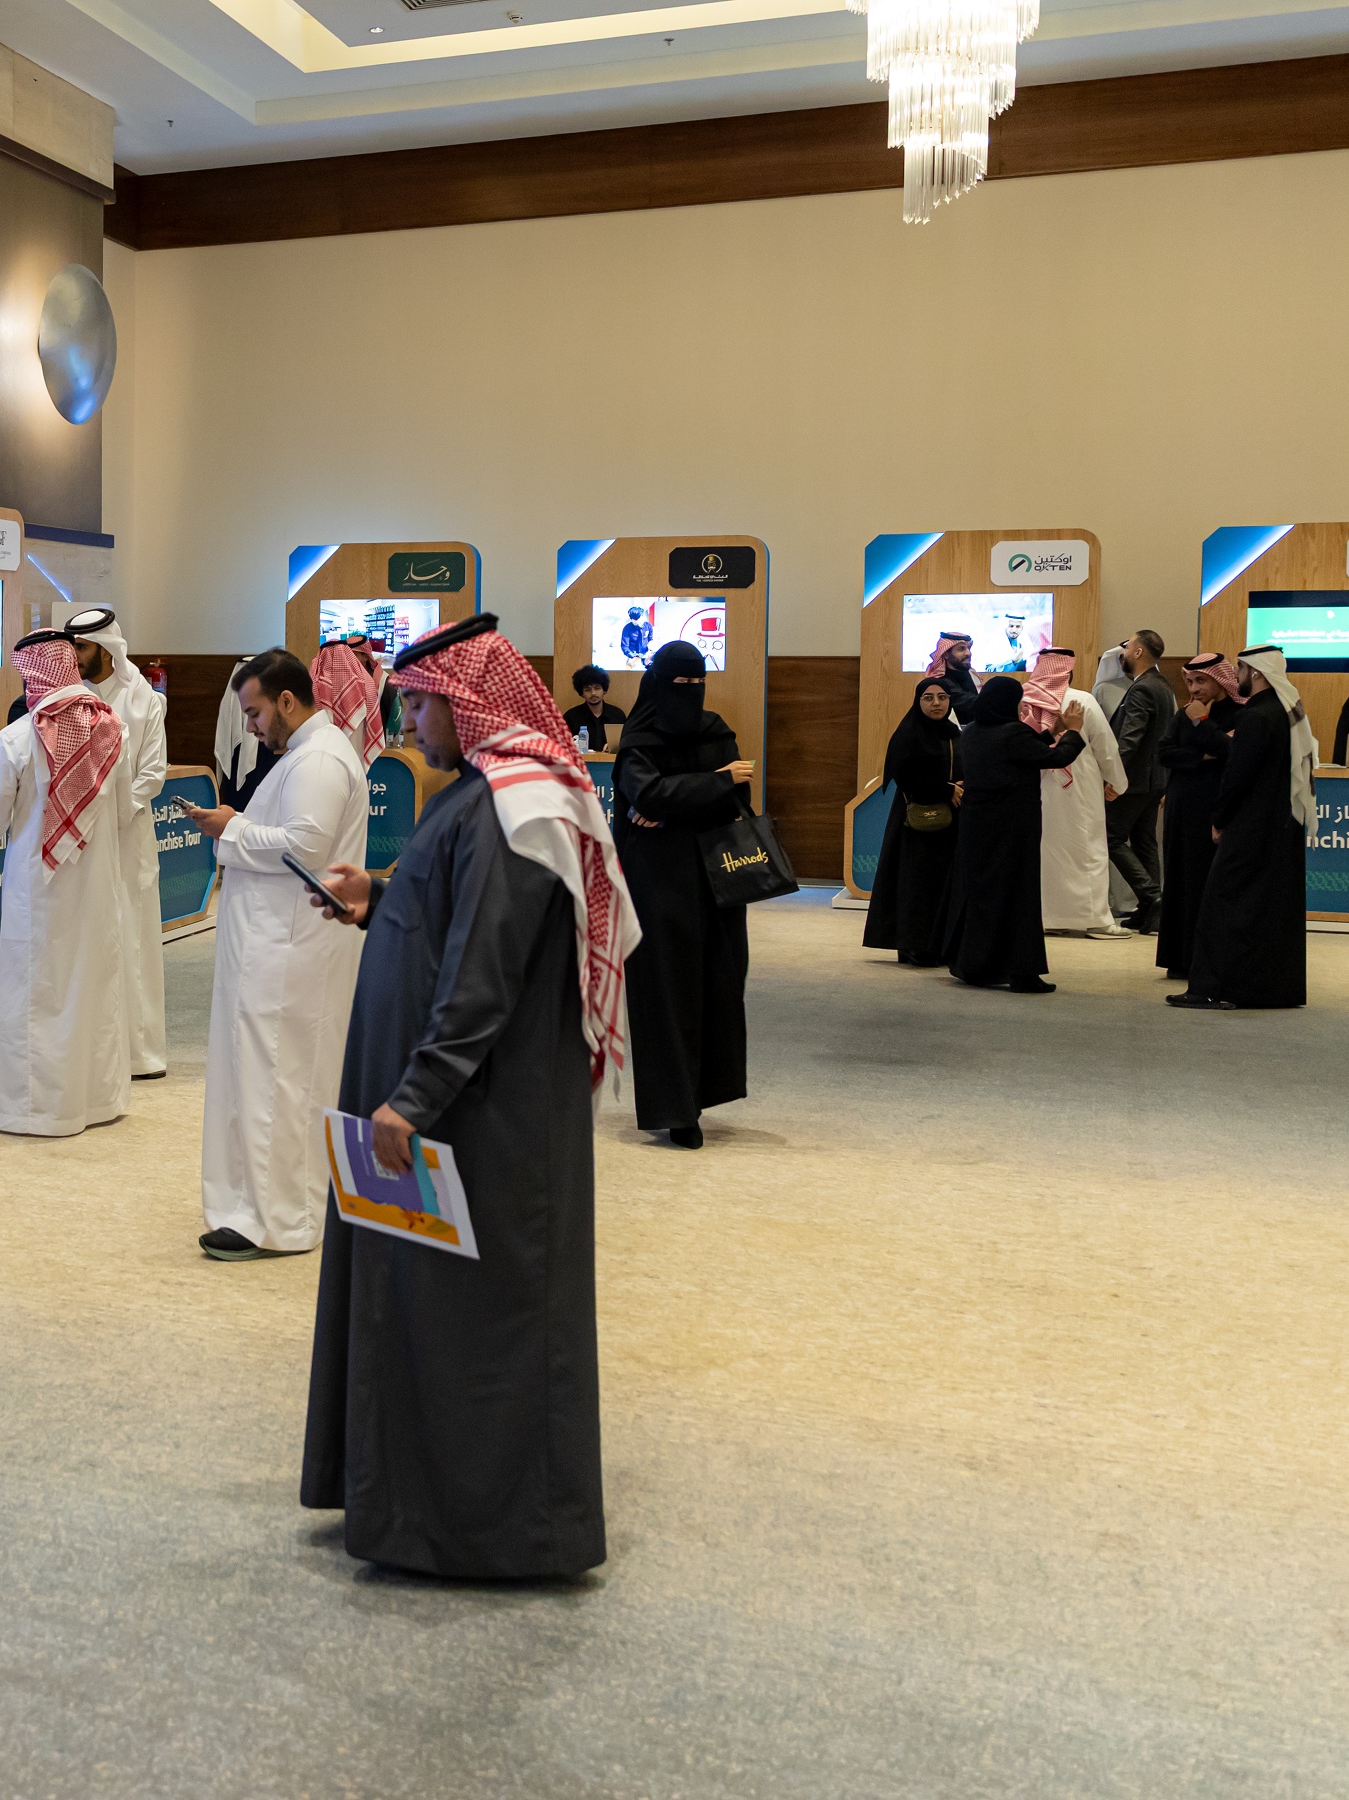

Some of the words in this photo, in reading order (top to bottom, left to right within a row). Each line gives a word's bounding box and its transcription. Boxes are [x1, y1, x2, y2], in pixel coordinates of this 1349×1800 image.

[157, 831, 184, 852] anchise
[184, 829, 202, 847] Tour
[720, 846, 769, 873] Harrods
